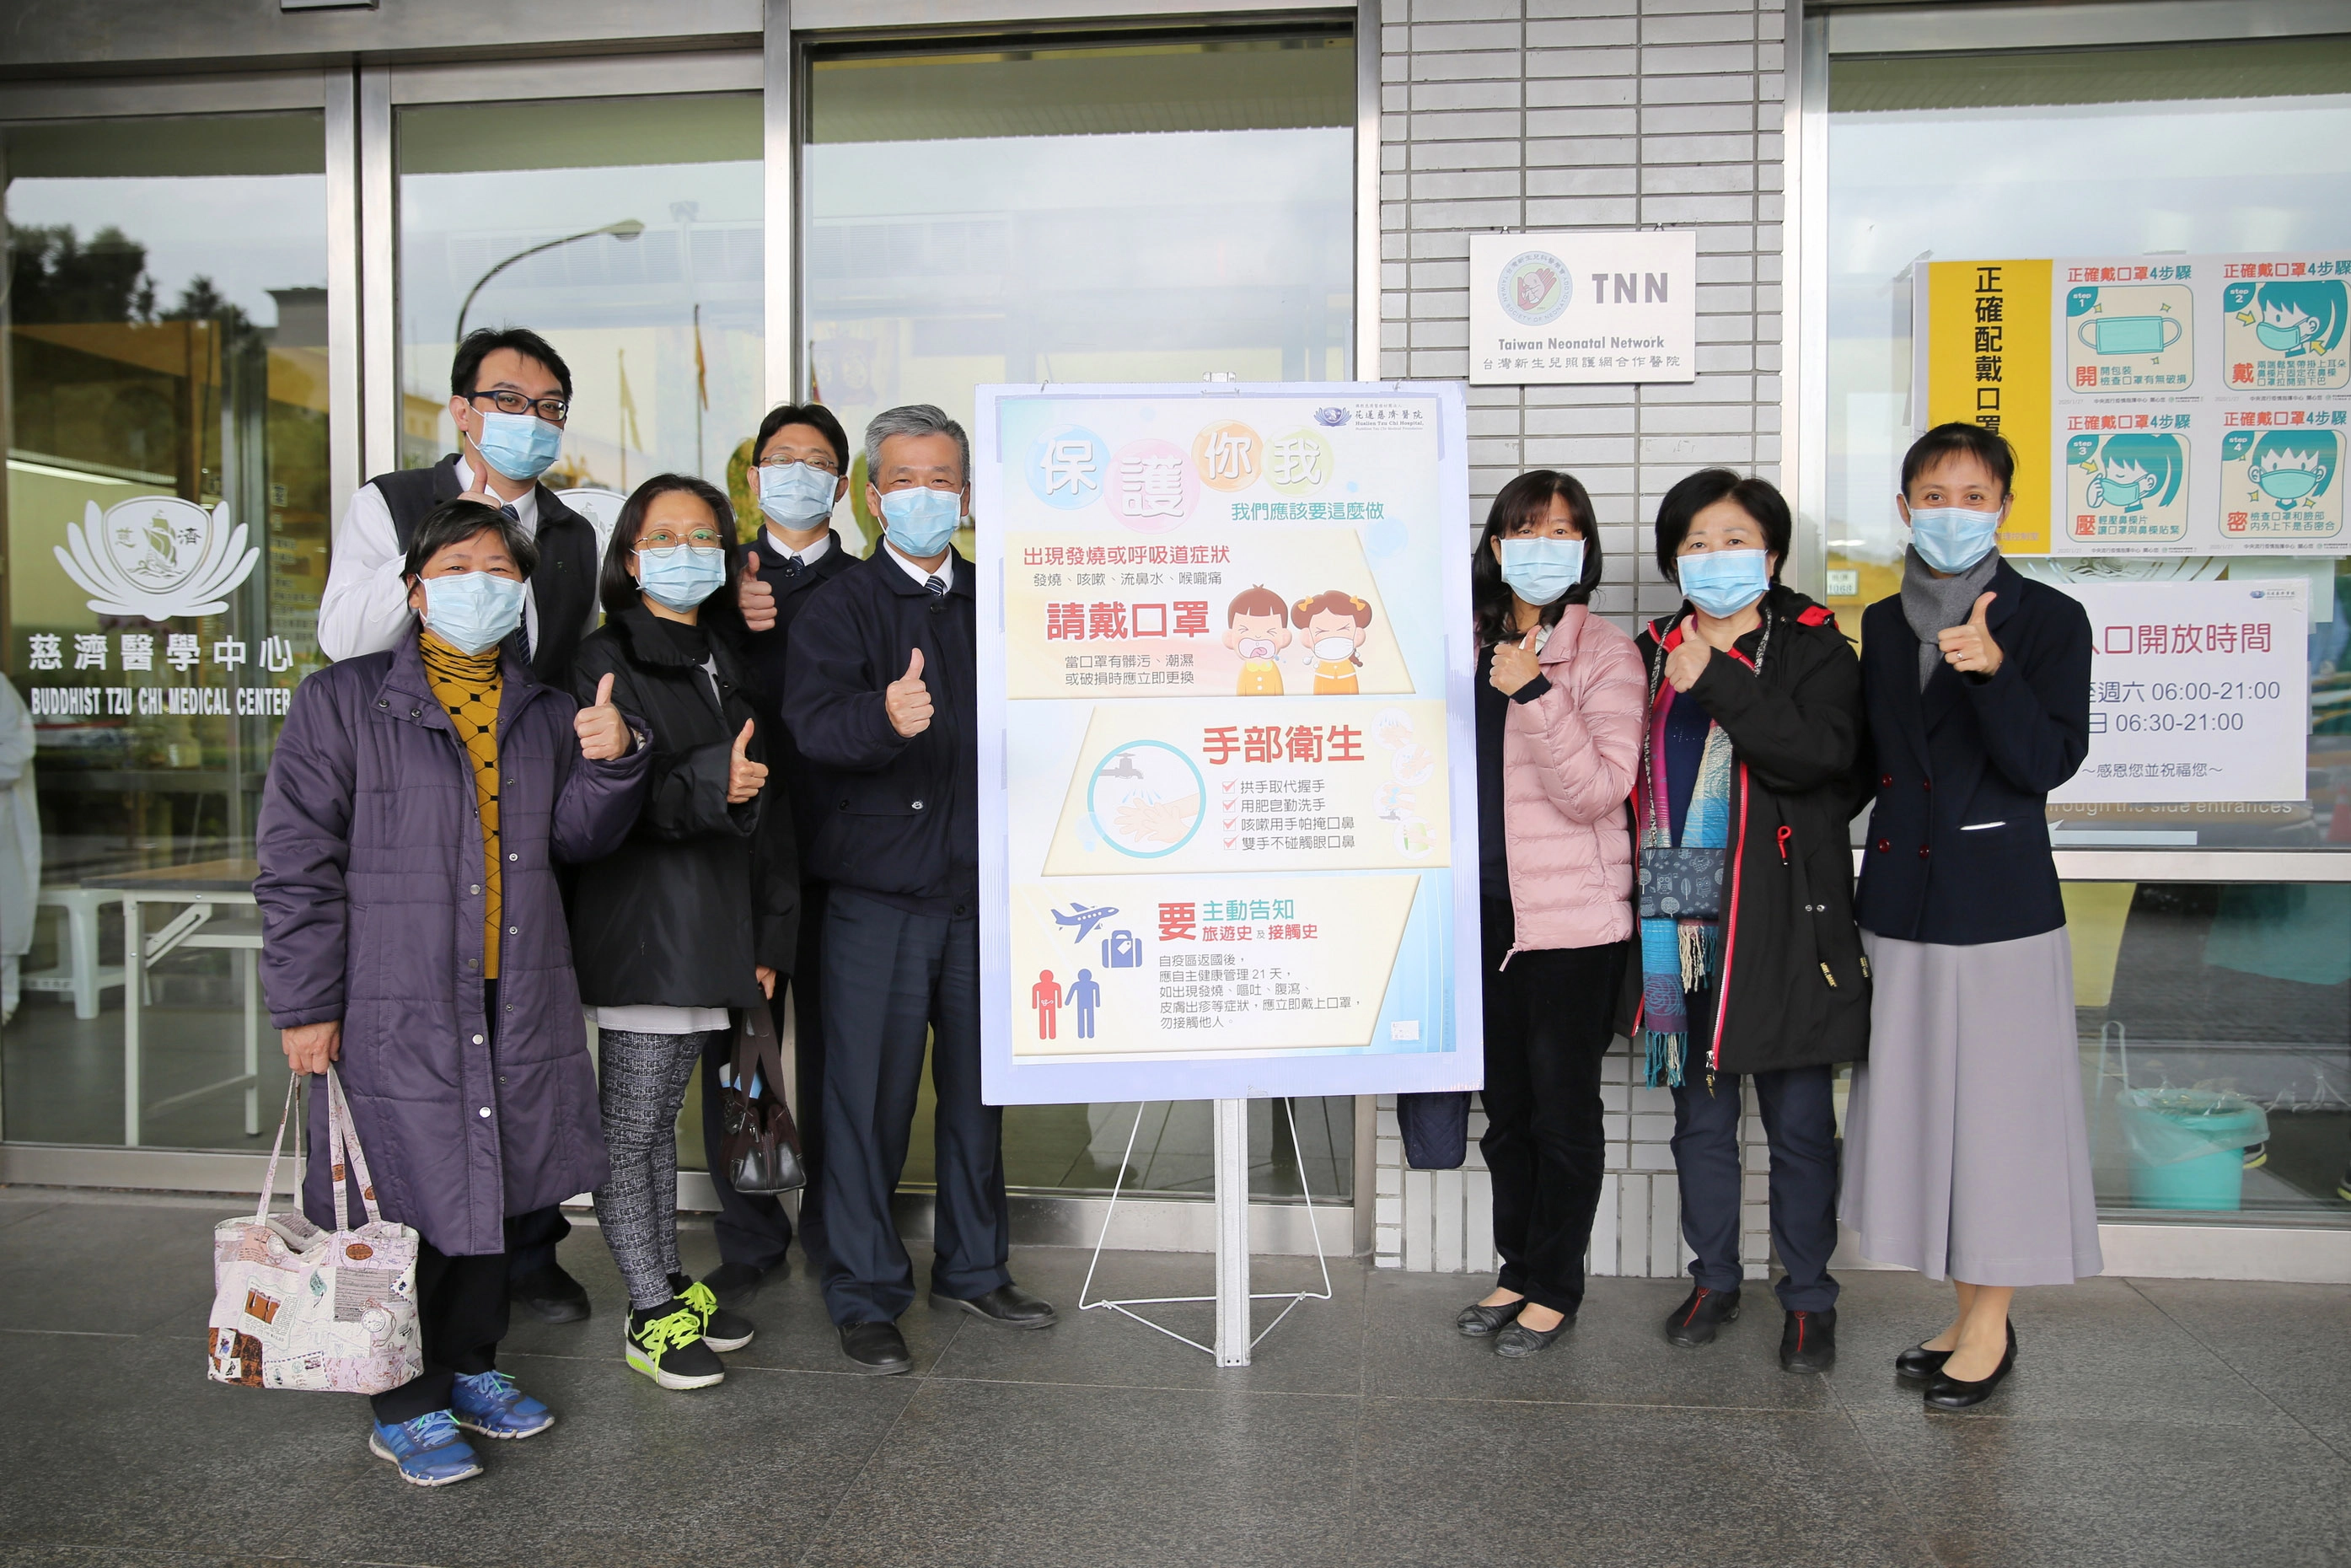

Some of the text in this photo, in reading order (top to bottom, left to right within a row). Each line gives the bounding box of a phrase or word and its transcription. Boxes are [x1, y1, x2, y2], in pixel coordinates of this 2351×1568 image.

[2067, 265, 2192, 282] 正確戴口罩4步驟
[2223, 260, 2351, 278] 正確戴口罩4步驟
[1591, 272, 1668, 303] TNN
[2230, 287, 2249, 296] step
[2080, 298, 2085, 308] 1
[2235, 294, 2244, 303] 2
[1498, 336, 1665, 351] Taiwan Neonatal Network
[1483, 356, 1681, 370] 台灣新生兒照護網合作醫院
[2100, 366, 2132, 376] 開包裝
[2076, 366, 2097, 387] 開
[2232, 362, 2254, 384] 戴
[2067, 414, 2191, 431] 正確戴口罩4步驟
[2223, 411, 2347, 427] 正確戴口罩4步驟
[2079, 446, 2087, 456] 3
[2233, 443, 2242, 452] 4
[1039, 432, 1322, 519] 保護你我
[1232, 502, 1384, 522] 我們應該要這麼做
[2075, 515, 2096, 536] 壓
[2227, 511, 2248, 532] 密
[1023, 545, 1231, 567] 出現發燒或呼吸道症狀
[1047, 601, 1210, 641] 請戴口罩
[2092, 623, 2271, 655] 口開放時間
[29, 633, 293, 673] 慈濟醫學中心
[1065, 670, 1194, 686] 或破損時應立即更換
[2151, 681, 2280, 701] 06:00-21:00
[30, 687, 291, 715] BUDDHIST TZU CHI MEDICAL CENTER
[2116, 712, 2243, 732] 06:30-21:00
[1203, 724, 1365, 765] 手部衛生
[1240, 779, 1326, 795] 拱手取代握手
[1241, 797, 1326, 814] 用肥皂勤洗手
[1241, 816, 1355, 832] 咳嗽用手帕掩口鼻
[1242, 835, 1355, 851] 雙手不碰觸眼口鼻
[1202, 899, 1295, 921] 主動告知
[1158, 902, 1196, 942] 要
[1202, 924, 1318, 942] 旅遊史 及 接觸史
[1159, 969, 1249, 983] 應自主健康管理
[1253, 969, 1265, 980] 21
